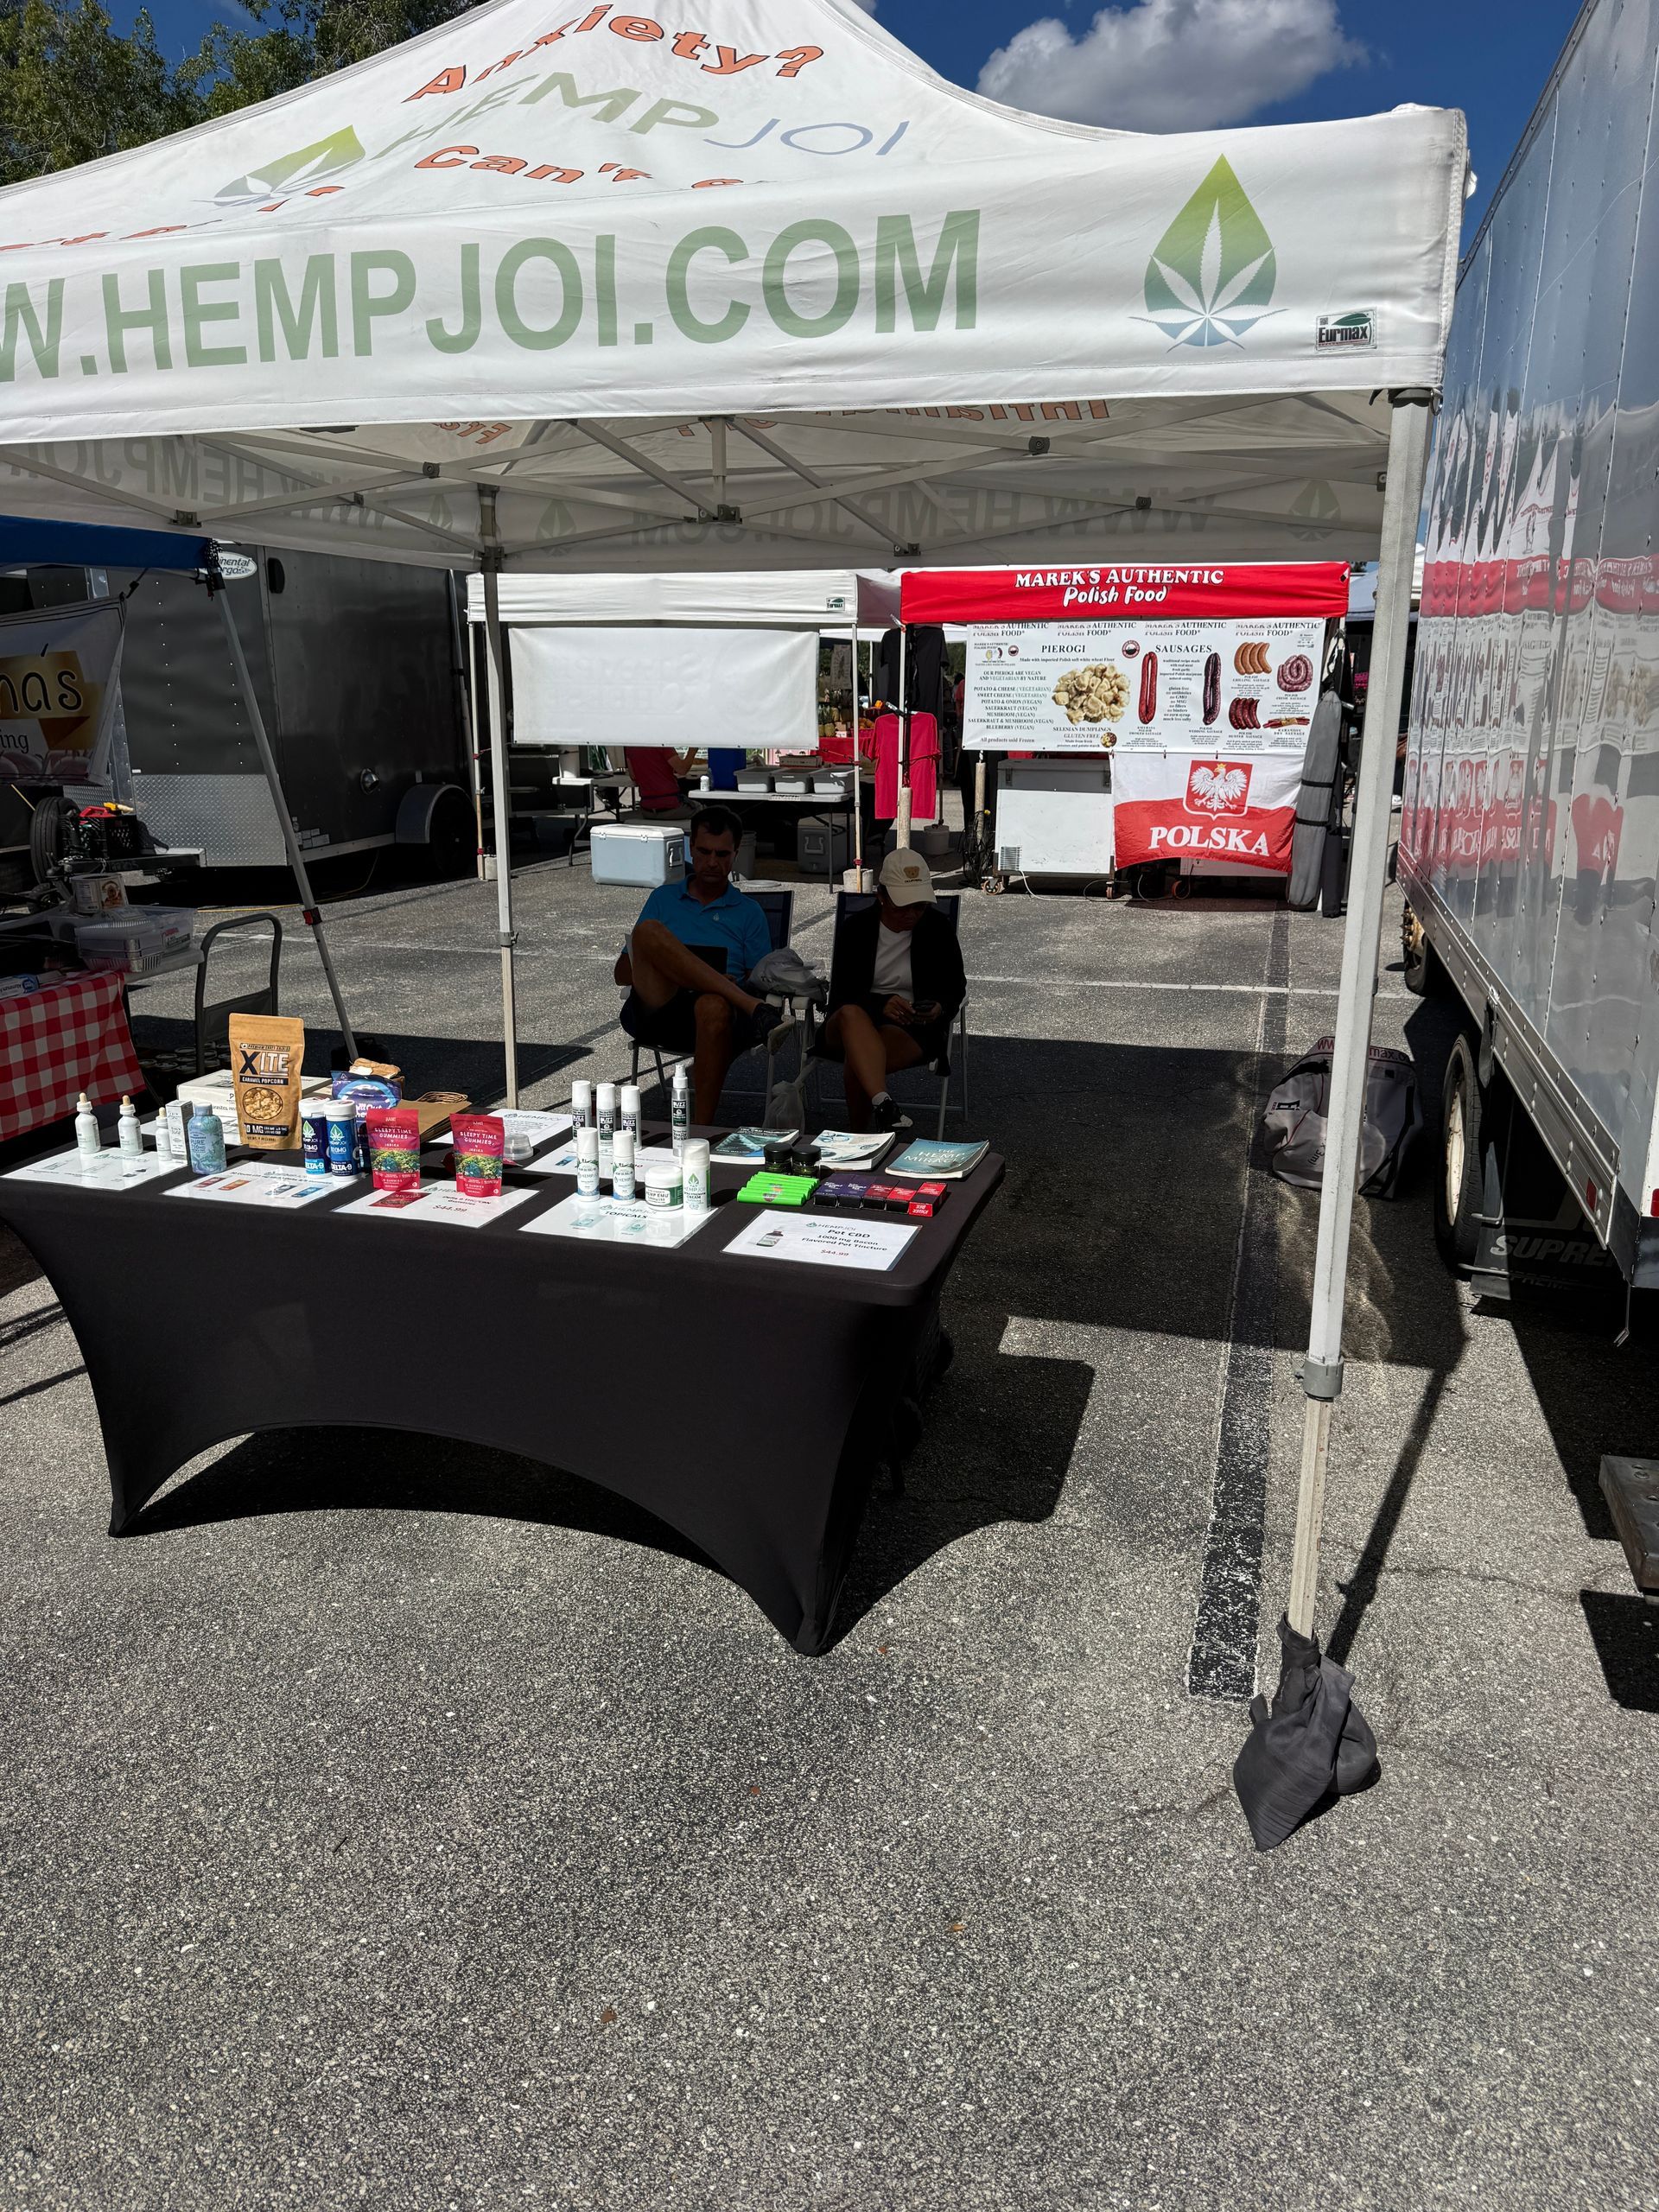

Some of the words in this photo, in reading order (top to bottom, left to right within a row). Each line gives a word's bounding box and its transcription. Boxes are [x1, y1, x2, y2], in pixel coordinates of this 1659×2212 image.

[403, 5, 824, 103] Anxiety?
[414, 145, 652, 184] Can't
[1318, 326, 1369, 344] Eurmax
[219, 556, 251, 567] inental
[222, 566, 238, 575] rgo
[1015, 569, 1101, 588] MAREK'S
[1105, 569, 1225, 585] AUTHENTIC
[1063, 586, 1119, 607] Polish
[1124, 586, 1167, 605] Food
[1007, 621, 1049, 630] AUTHENTIC
[1041, 645, 1086, 653] PIEROGI
[1154, 645, 1212, 653] SAUSAGES
[1147, 825, 1270, 857] POLSKA
[239, 1050, 289, 1075] XITE
[605, 1211, 648, 1219] TOPICALS
[1490, 1235, 1612, 1268] SUPRE
